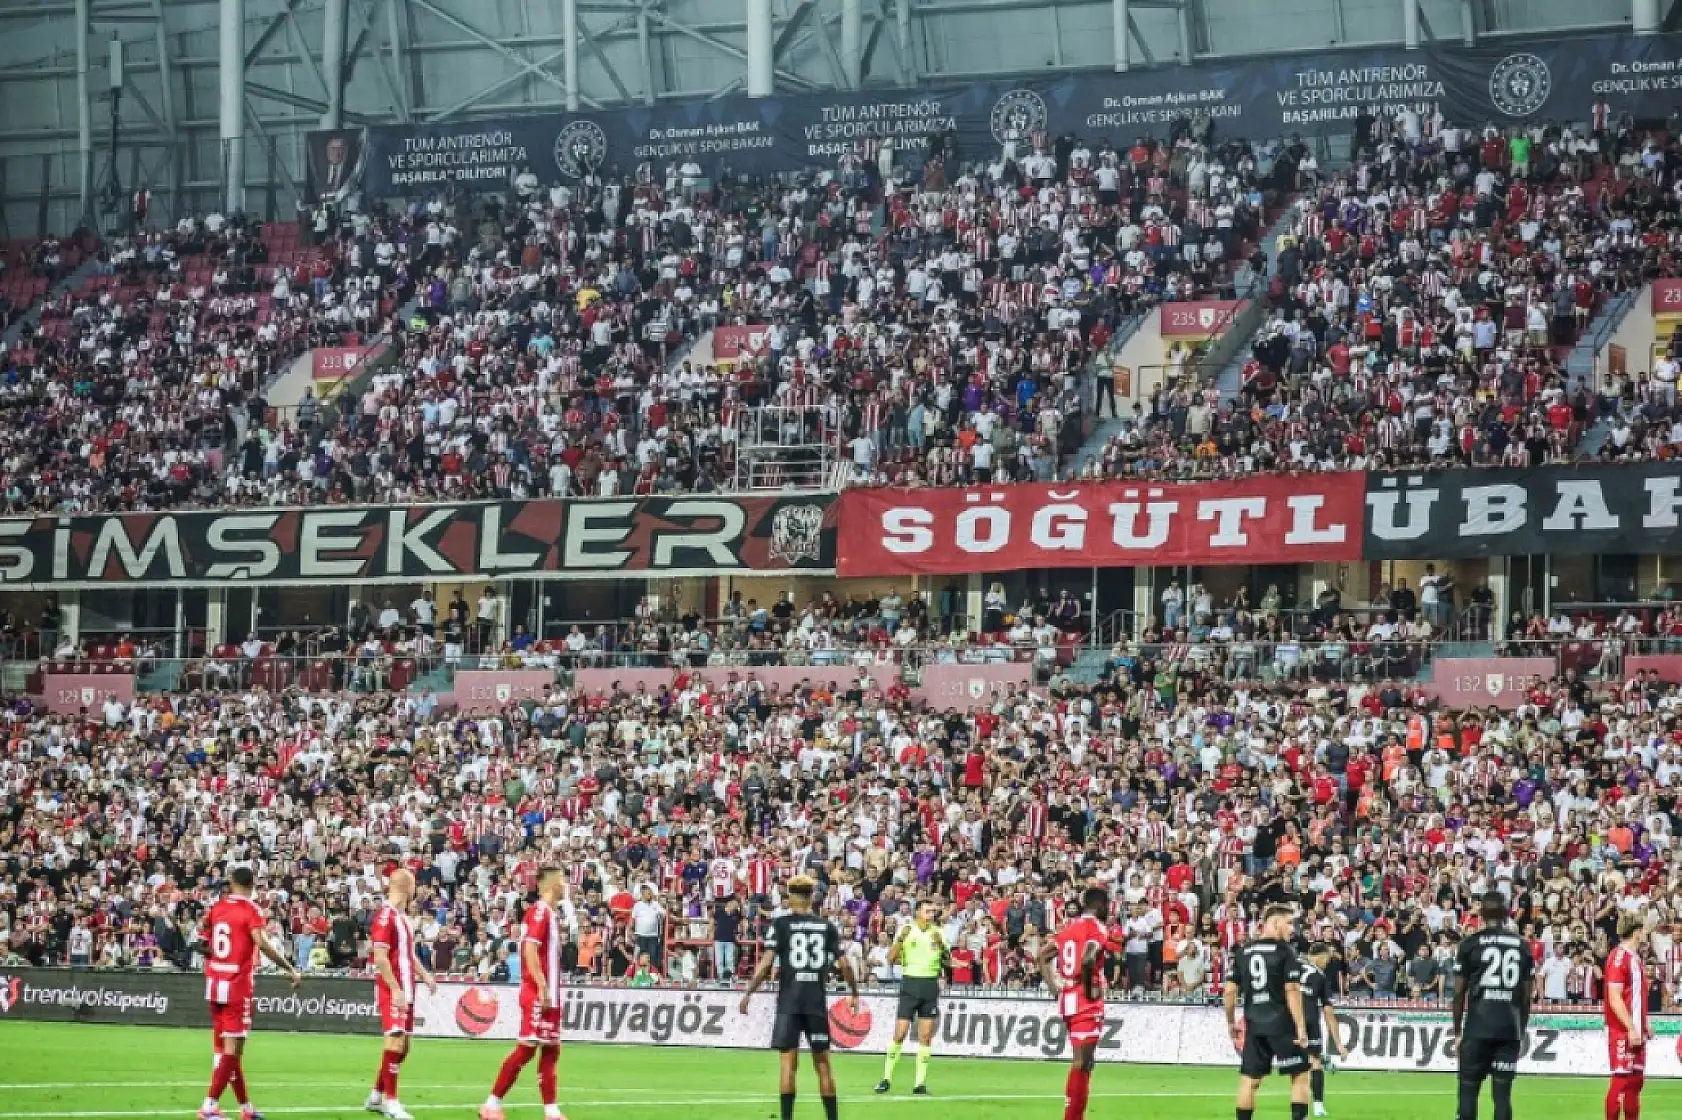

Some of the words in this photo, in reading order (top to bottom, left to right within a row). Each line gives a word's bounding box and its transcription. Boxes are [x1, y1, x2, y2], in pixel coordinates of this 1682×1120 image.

[1295, 69, 1333, 87] TÜM
[1338, 63, 1427, 82] ANTRENÖR
[1632, 61, 1674, 73] Osman
[1277, 90, 1297, 106] VE
[1300, 81, 1446, 105] SPORCULARIMIZA
[1651, 76, 1669, 90] VE
[821, 103, 855, 122] TÜM
[859, 99, 941, 117] ANTRENÖR
[1122, 95, 1163, 107] Osman
[1087, 109, 1139, 128] GENÇLİK
[1140, 110, 1156, 123] VE
[1283, 104, 1358, 125] BAŞARILAR
[437, 130, 512, 150] ANTRENÖR
[804, 125, 824, 139] VE
[388, 153, 405, 168] VE
[408, 146, 527, 167] SPORCULARIMIZA
[700, 139, 731, 153] SPOR
[1172, 311, 1196, 326] 235
[1454, 675, 1480, 692] 132
[213, 923, 230, 959] 6
[789, 932, 825, 969] 83
[1062, 940, 1077, 976] 9
[1479, 946, 1521, 989] 26
[1249, 954, 1268, 990] 9
[24, 983, 103, 1010] trendyol
[562, 990, 727, 1041] ünyagöz
[910, 1001, 1124, 1056] ünyagz
